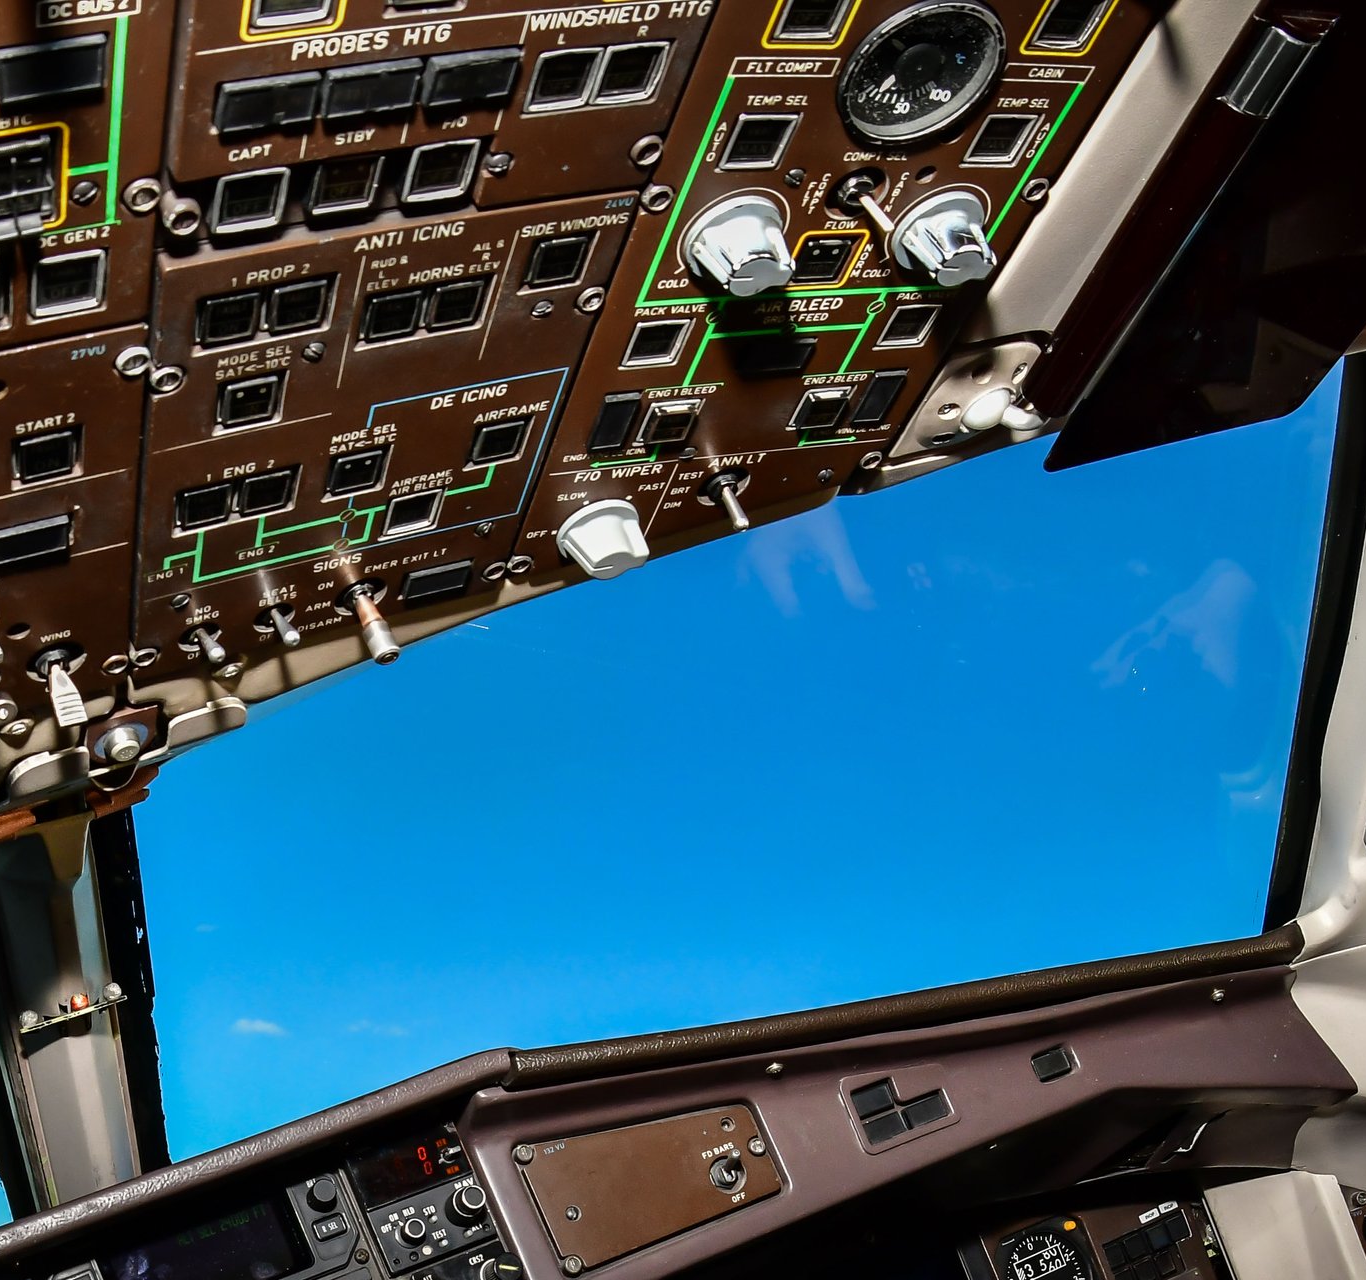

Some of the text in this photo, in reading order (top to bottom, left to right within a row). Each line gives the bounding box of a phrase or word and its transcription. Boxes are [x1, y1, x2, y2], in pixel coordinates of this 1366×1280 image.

[529, 0, 713, 32] WINDSHIELD HTG
[291, 24, 451, 62] PROBES HTG
[746, 61, 822, 74] FLT COMPT
[1029, 67, 1065, 79] CABIN
[746, 93, 808, 107] TEMP SEL
[928, 89, 951, 102] 100
[335, 128, 375, 146] STBY
[228, 144, 273, 161] CAPT
[521, 212, 629, 238] SIDE WINDOWS
[825, 220, 858, 230] FLOW
[354, 221, 465, 252] ANTI ICING
[409, 264, 464, 284] HORNS
[658, 277, 689, 290] COLD
[635, 302, 707, 317] PACK VALVE
[430, 382, 508, 410] DE ICING
[473, 400, 549, 424] AIRFRAME
[708, 453, 766, 469] ANN LT
[573, 463, 663, 483] F/O WIPER
[678, 470, 705, 481] TEST
[313, 552, 363, 574] SIGNS
[305, 600, 332, 612] ARM
[297, 616, 343, 633] DISARM
[40, 629, 71, 643] WING
[432, 1229, 447, 1240] TEST
